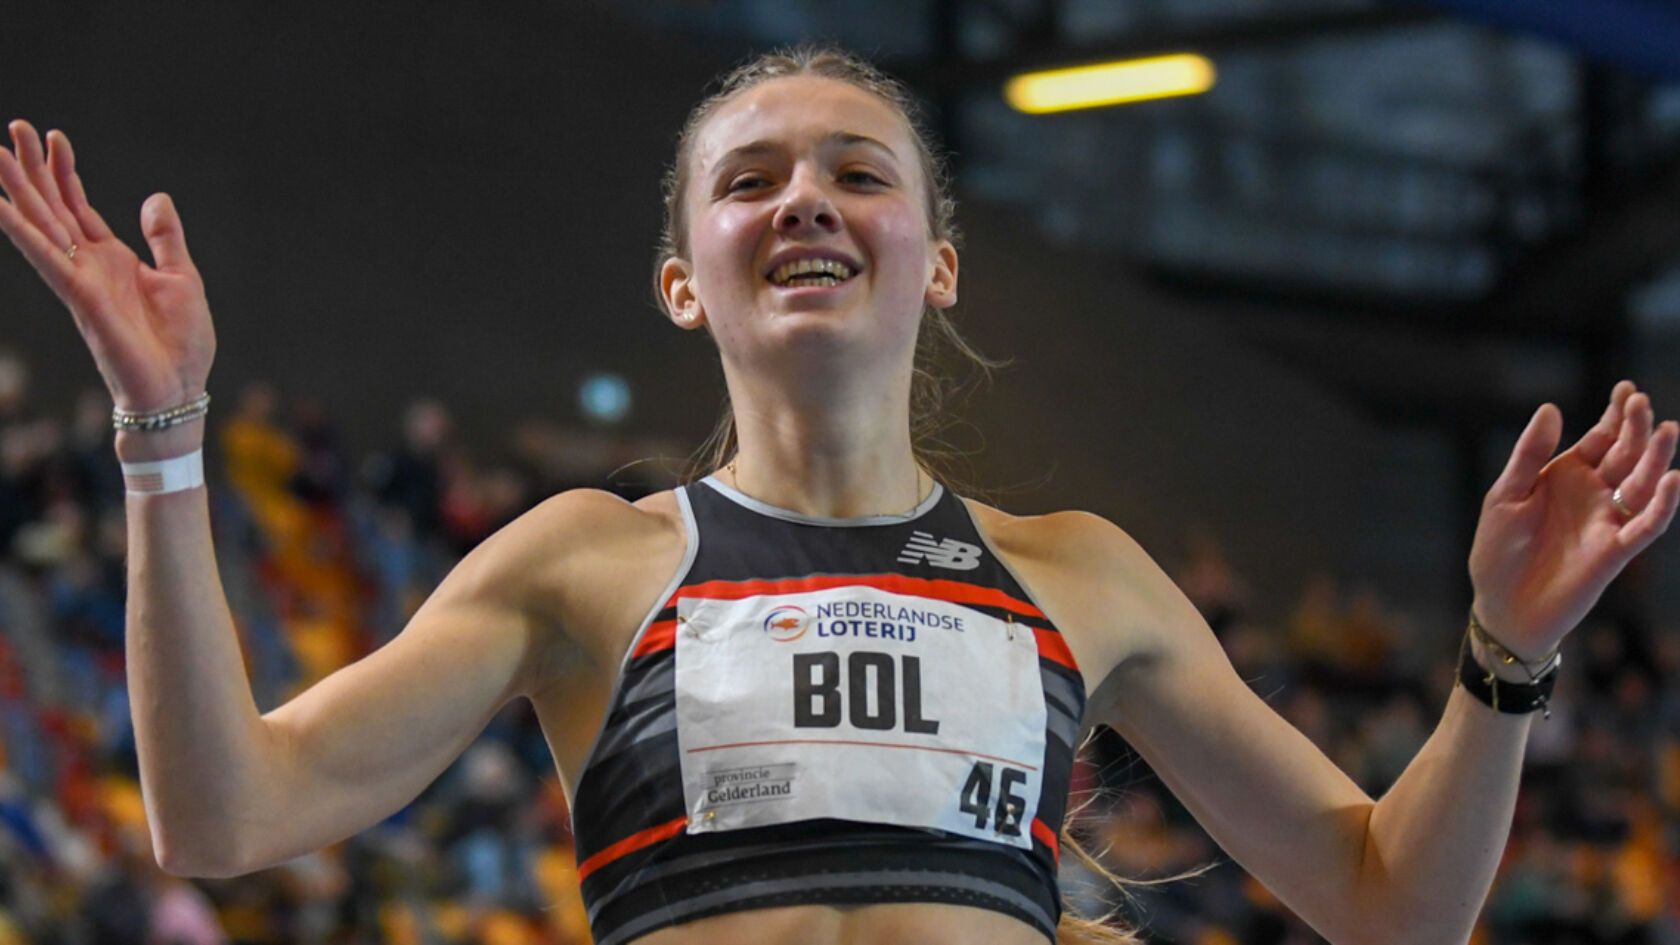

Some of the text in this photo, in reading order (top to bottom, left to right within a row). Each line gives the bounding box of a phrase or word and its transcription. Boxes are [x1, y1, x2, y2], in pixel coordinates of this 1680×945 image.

[817, 602, 964, 632] NEDERLANDSE
[816, 620, 917, 642] LOTERIJ
[793, 650, 940, 735] BOL
[714, 767, 770, 785] provincie
[708, 781, 791, 803] Gelderland
[959, 761, 1027, 837] 46
